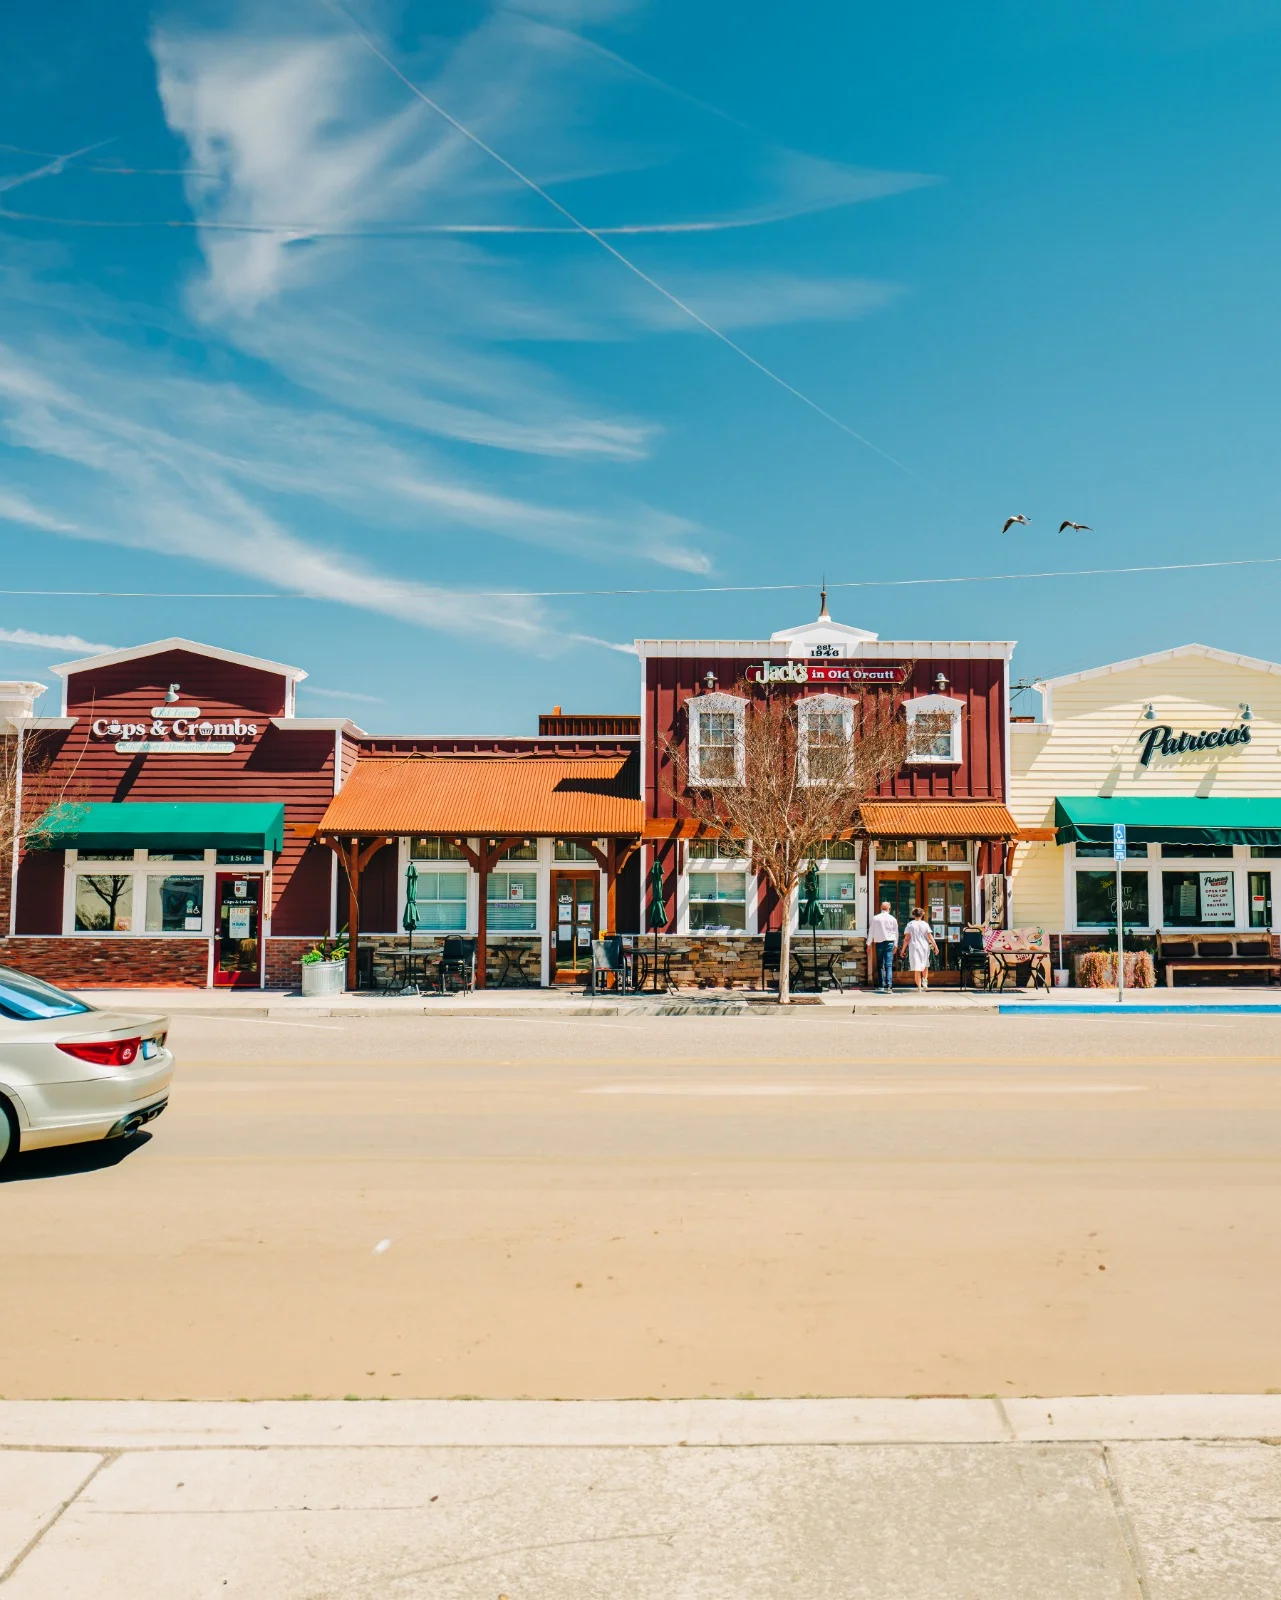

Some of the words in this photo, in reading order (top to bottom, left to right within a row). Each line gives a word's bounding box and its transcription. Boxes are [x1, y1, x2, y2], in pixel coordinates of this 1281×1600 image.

[755, 661, 809, 684] Jack's
[811, 669, 826, 679] in
[828, 669, 850, 679] Old
[853, 669, 895, 679] Orcutt
[154, 708, 171, 717] Old
[174, 708, 198, 717] Town
[150, 719, 169, 736] &
[1138, 724, 1251, 769] Patricio's
